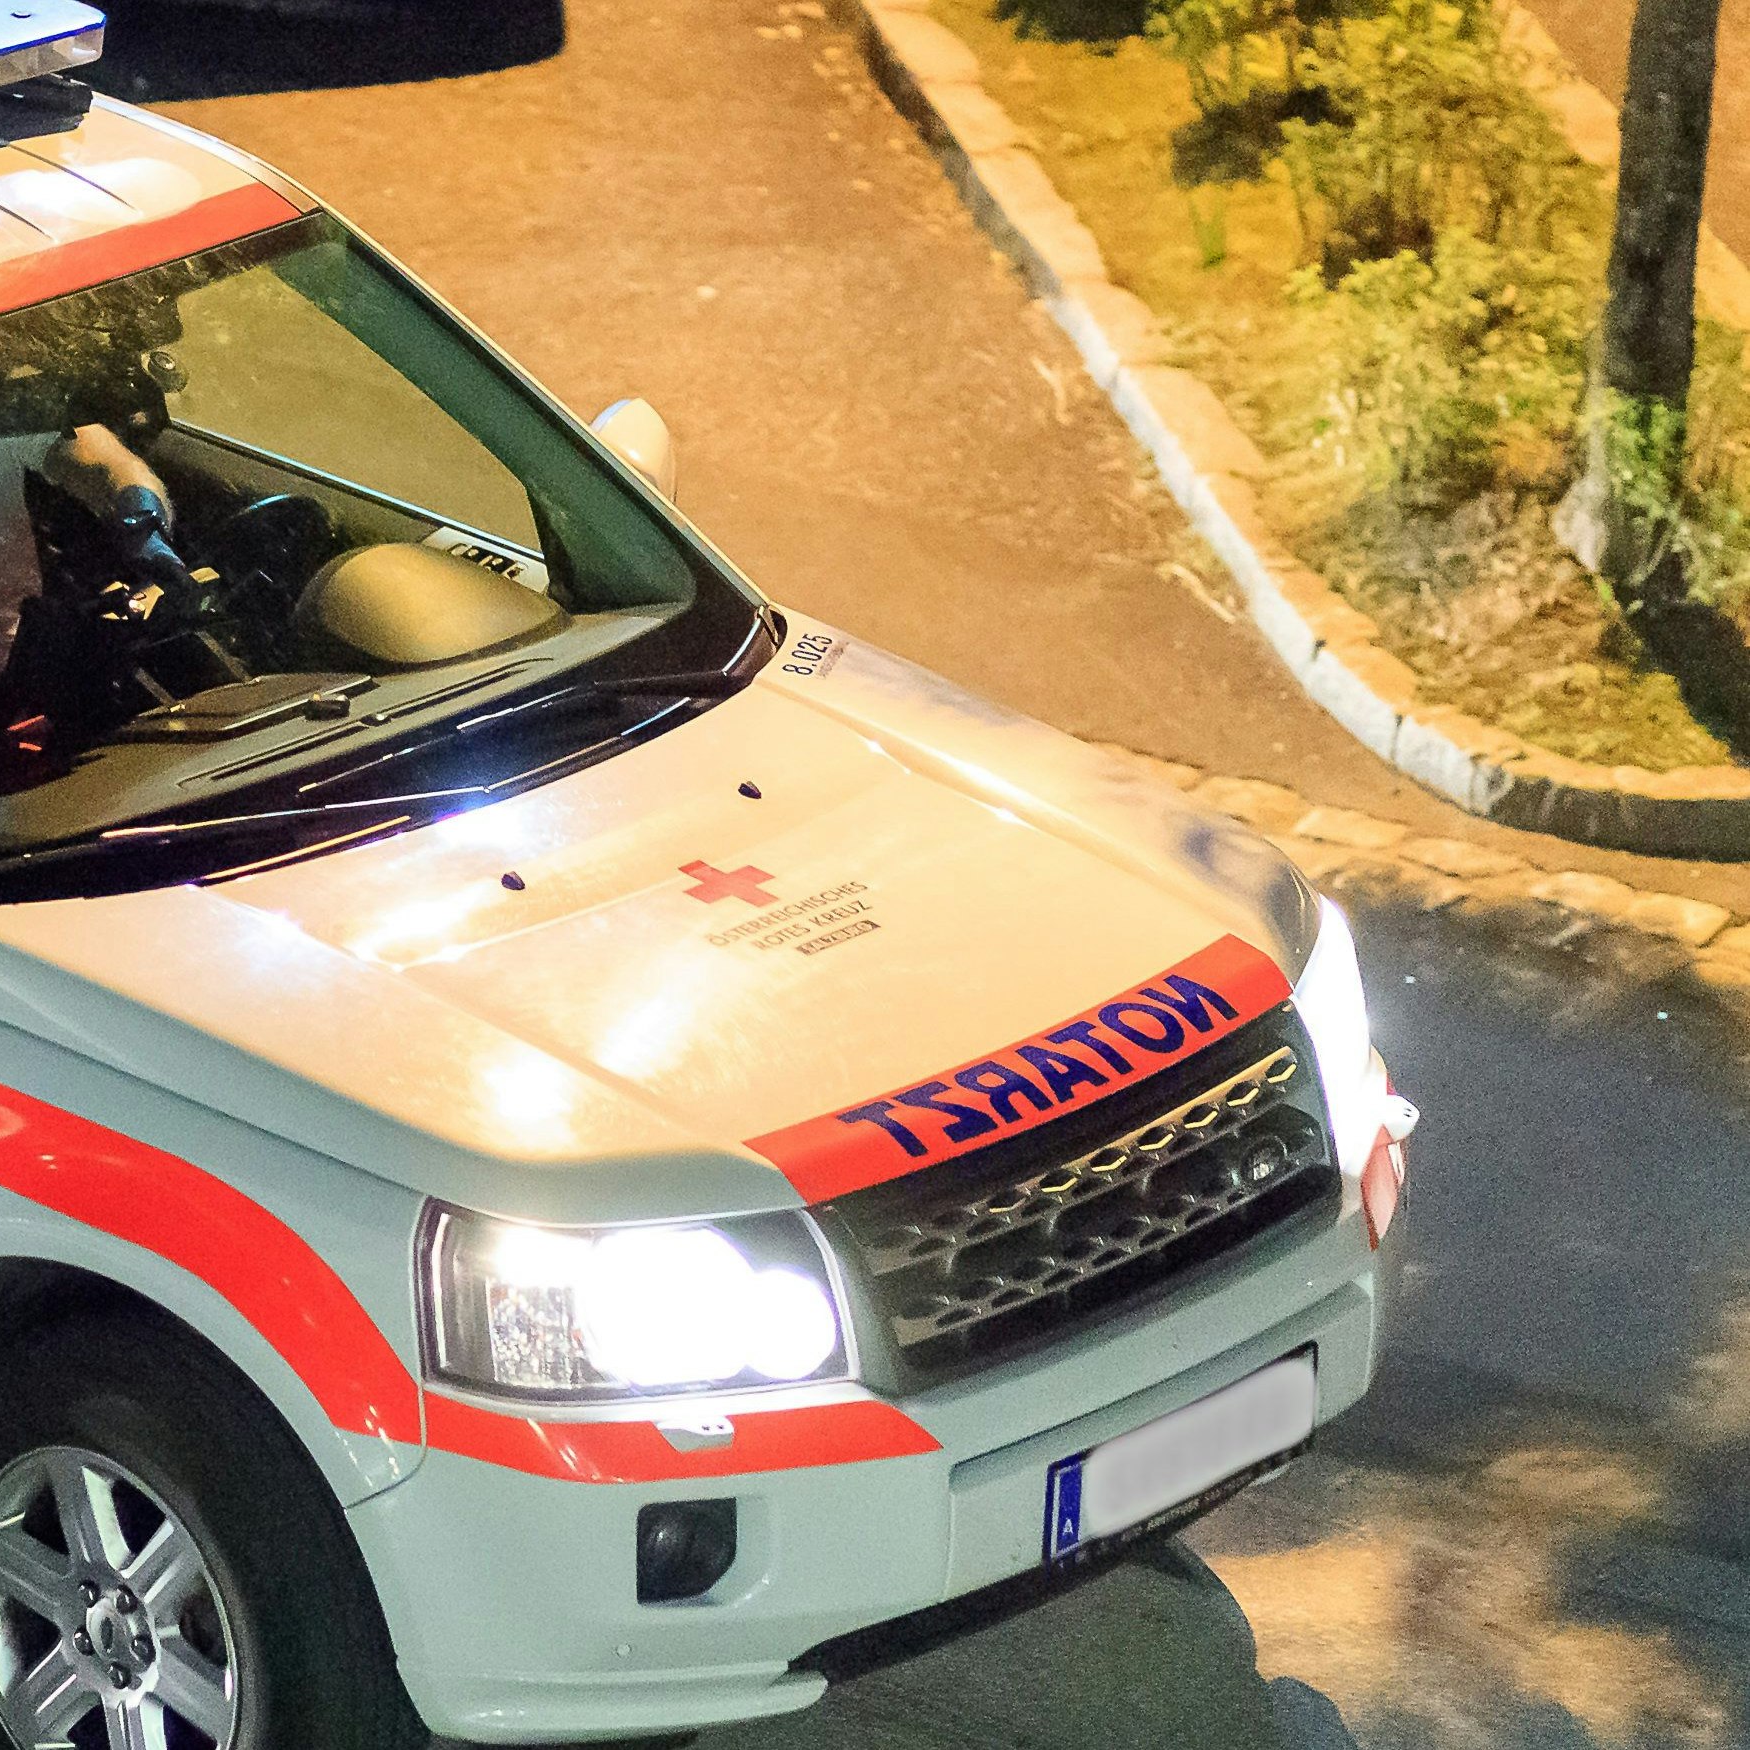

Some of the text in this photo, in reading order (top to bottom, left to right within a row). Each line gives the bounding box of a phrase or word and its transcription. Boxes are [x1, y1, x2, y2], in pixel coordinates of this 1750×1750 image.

[782, 633, 833, 675] 8.025
[706, 881, 867, 947] ÖSTERREICHISCHES
[809, 900, 872, 928] KREUZ
[1062, 1518, 1073, 1536] A
